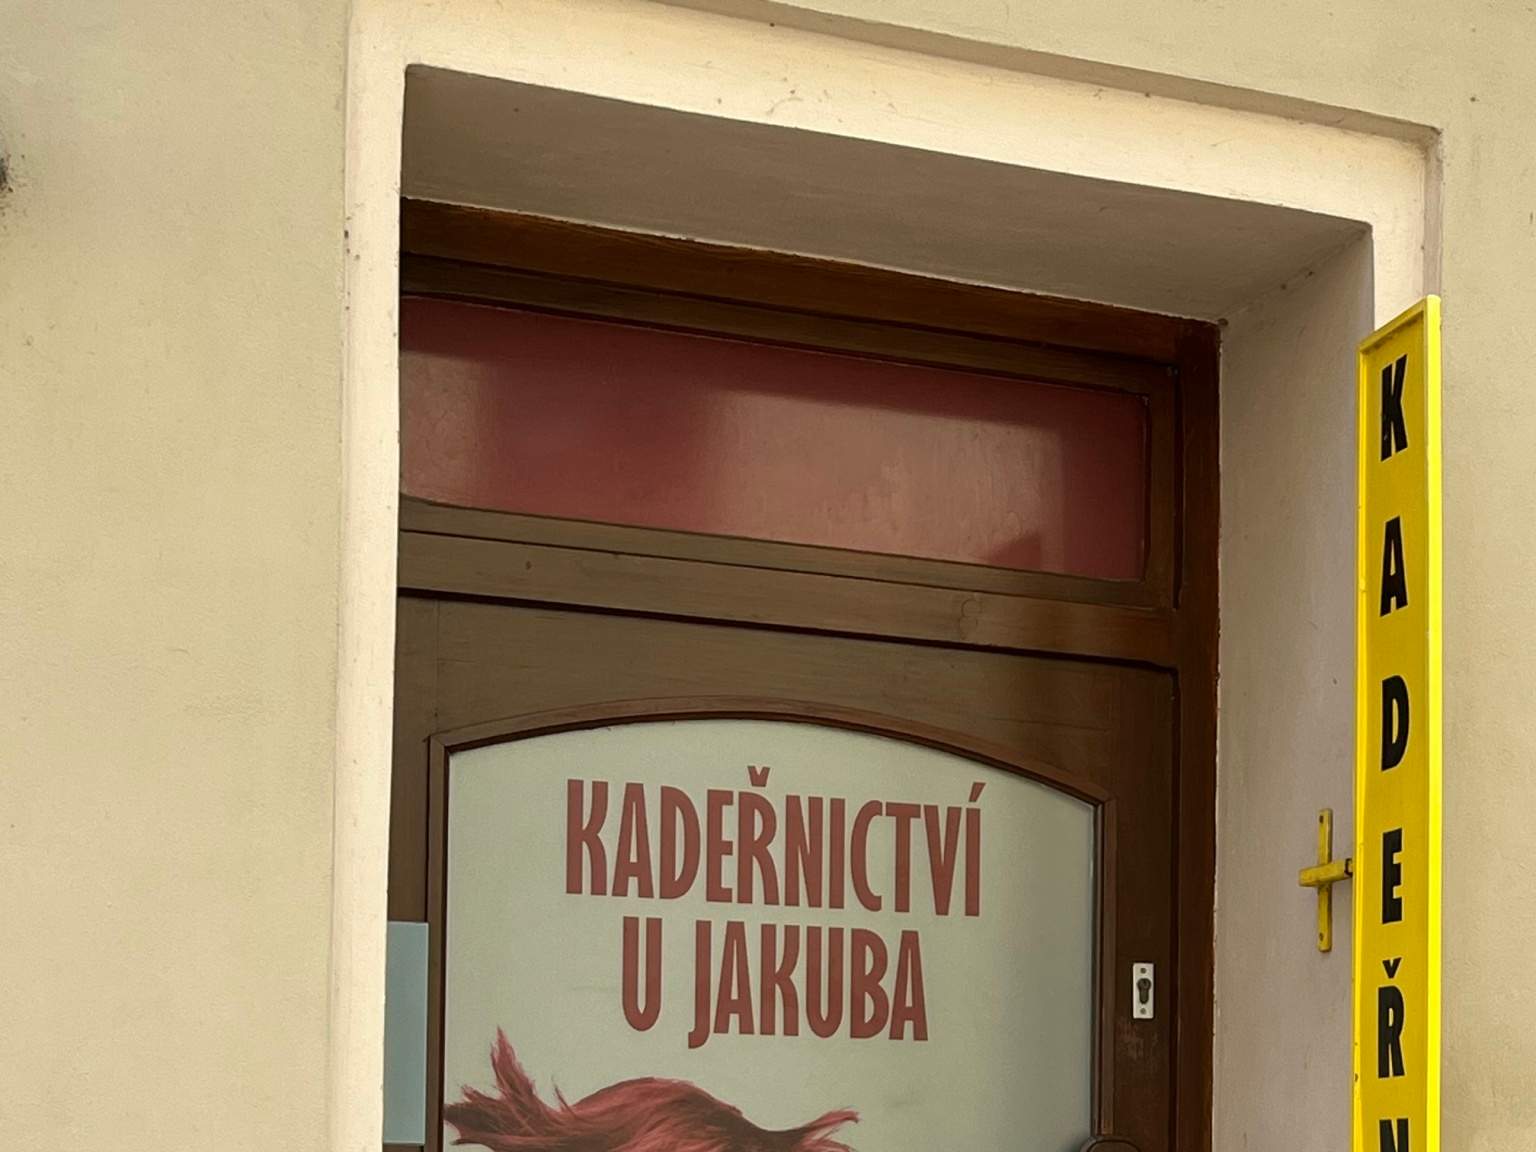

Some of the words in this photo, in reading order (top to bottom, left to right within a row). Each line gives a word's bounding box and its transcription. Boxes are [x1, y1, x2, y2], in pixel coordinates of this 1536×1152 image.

[565, 765, 986, 917] KADEŘNICTVÍ
[621, 916, 662, 1032] U
[688, 920, 929, 1049] JAKUBA
